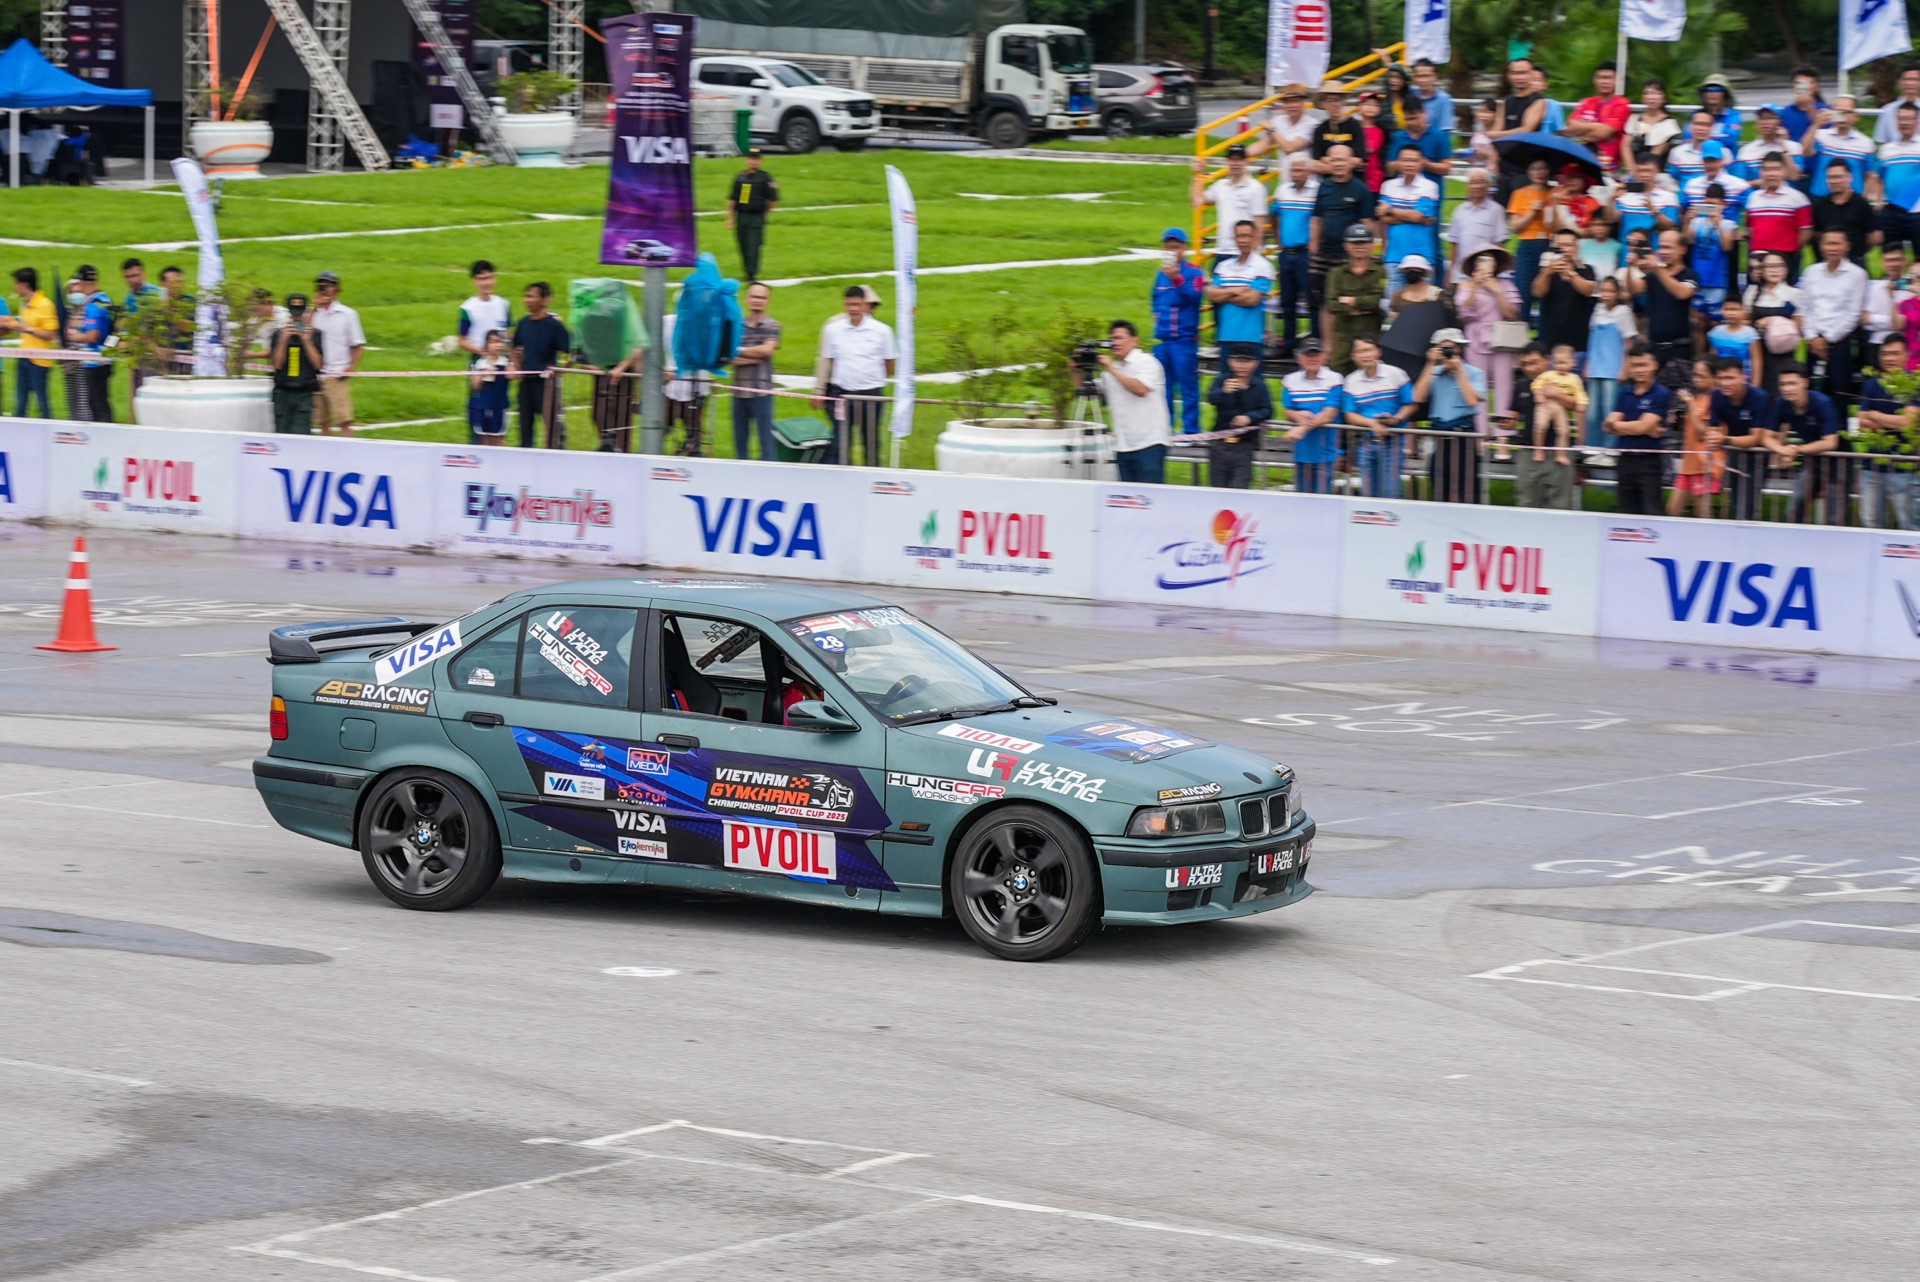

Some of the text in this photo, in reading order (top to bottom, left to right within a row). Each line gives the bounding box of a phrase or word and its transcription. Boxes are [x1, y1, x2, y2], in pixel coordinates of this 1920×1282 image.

[619, 136, 690, 164] VISA
[123, 457, 200, 502] PVOIL
[270, 467, 397, 530] VISA
[682, 494, 826, 560] VISA
[957, 510, 1053, 559] PVOIL
[1447, 541, 1551, 595] PVOIL
[1646, 557, 1821, 632] VISA
[546, 611, 575, 638] UR
[388, 628, 456, 674] VISA
[564, 634, 604, 665] RACING
[572, 628, 608, 659] ULTRA
[814, 635, 844, 650] 28
[529, 624, 612, 694] HUNGCAR
[541, 647, 588, 686] WORKSHOP
[315, 695, 349, 705] EXCLUSIVELY
[349, 699, 382, 709] DISTRIBUTED
[390, 704, 426, 713] VIETPASSION
[362, 684, 429, 705] RACING
[955, 726, 1034, 751] PVOIL
[629, 761, 665, 774] MEDIA
[715, 767, 789, 788] VIETNAM
[967, 748, 1020, 782] UR
[1023, 759, 1107, 789] ULTRA
[710, 782, 811, 807] GYMKHANA
[888, 772, 1006, 798] HUNGCAR
[912, 788, 978, 805] WORKSHOP
[1012, 770, 1103, 803] RACING
[1179, 782, 1221, 797] RACING
[606, 808, 668, 835] VISA
[707, 798, 845, 821] CHAMPIONSHIP PVOIL CUP 2025
[730, 823, 829, 875] PVOIL
[1274, 849, 1293, 862] ULTRA
[1190, 863, 1223, 877] ULTRA
[1257, 853, 1274, 874] UR
[1165, 868, 1189, 888] UR
[1186, 872, 1223, 887] RACING
